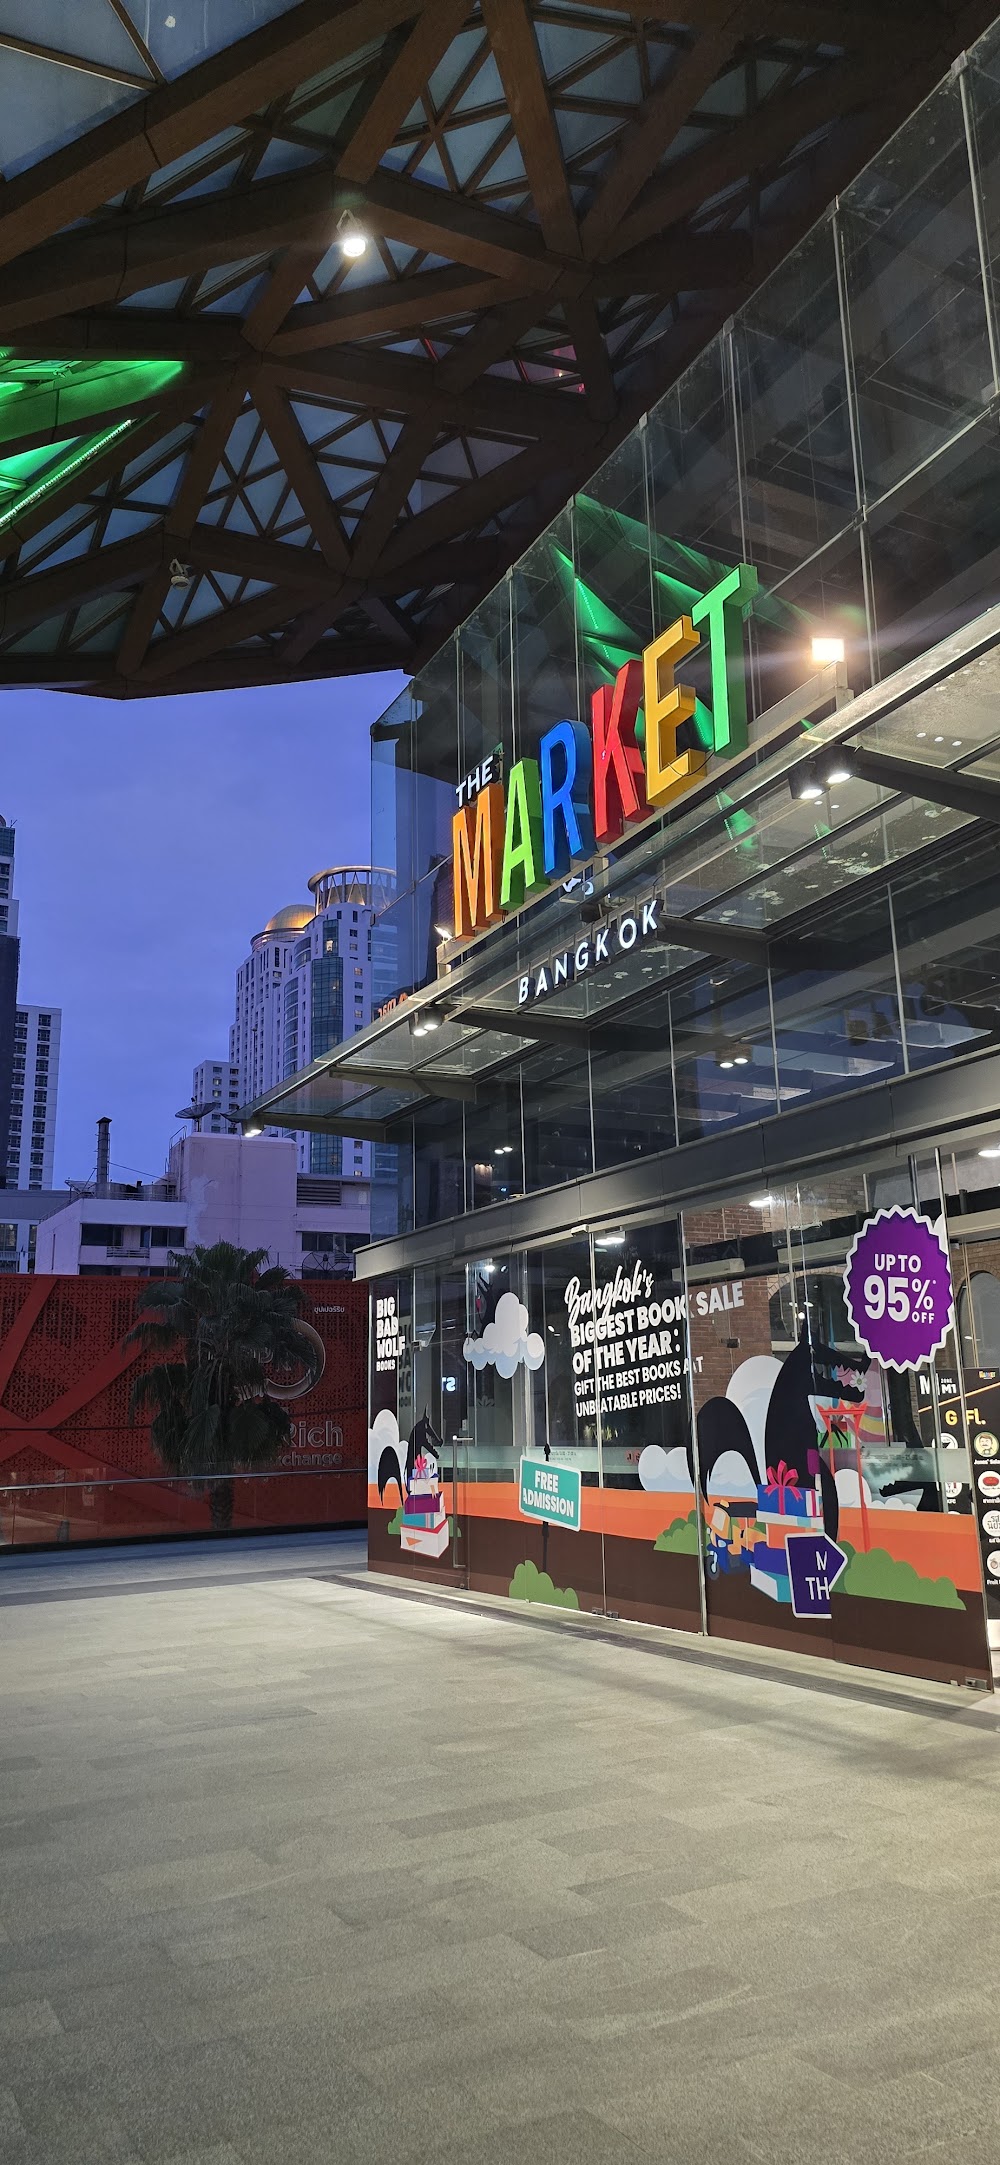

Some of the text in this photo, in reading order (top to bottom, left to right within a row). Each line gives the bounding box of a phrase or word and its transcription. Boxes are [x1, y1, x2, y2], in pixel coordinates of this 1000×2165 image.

[453, 563, 757, 941] MARKET
[455, 755, 493, 808] THE
[519, 899, 658, 1004] BANGKOK
[874, 1254, 922, 1273] UP TO
[564, 1260, 654, 1329] Bangkok's
[376, 1296, 396, 1319] BIG
[570, 1281, 745, 1347] BIGGEST BOOK SALE
[912, 1311, 935, 1324] OFF
[376, 1316, 399, 1339] BAD
[376, 1336, 406, 1359] WOLF
[572, 1349, 593, 1374] OF
[594, 1341, 625, 1370] THE
[376, 1359, 396, 1372] BOOKS
[574, 1356, 703, 1396] GIFT THE BEST BOOKS AT
[576, 1382, 682, 1417] UNBATABLE PRICES!
[941, 1383, 957, 1394] M1
[945, 1410, 958, 1426] G
[535, 1470, 559, 1493] FREE
[523, 1487, 574, 1518] ADMISSION
[804, 1576, 830, 1601] TH
